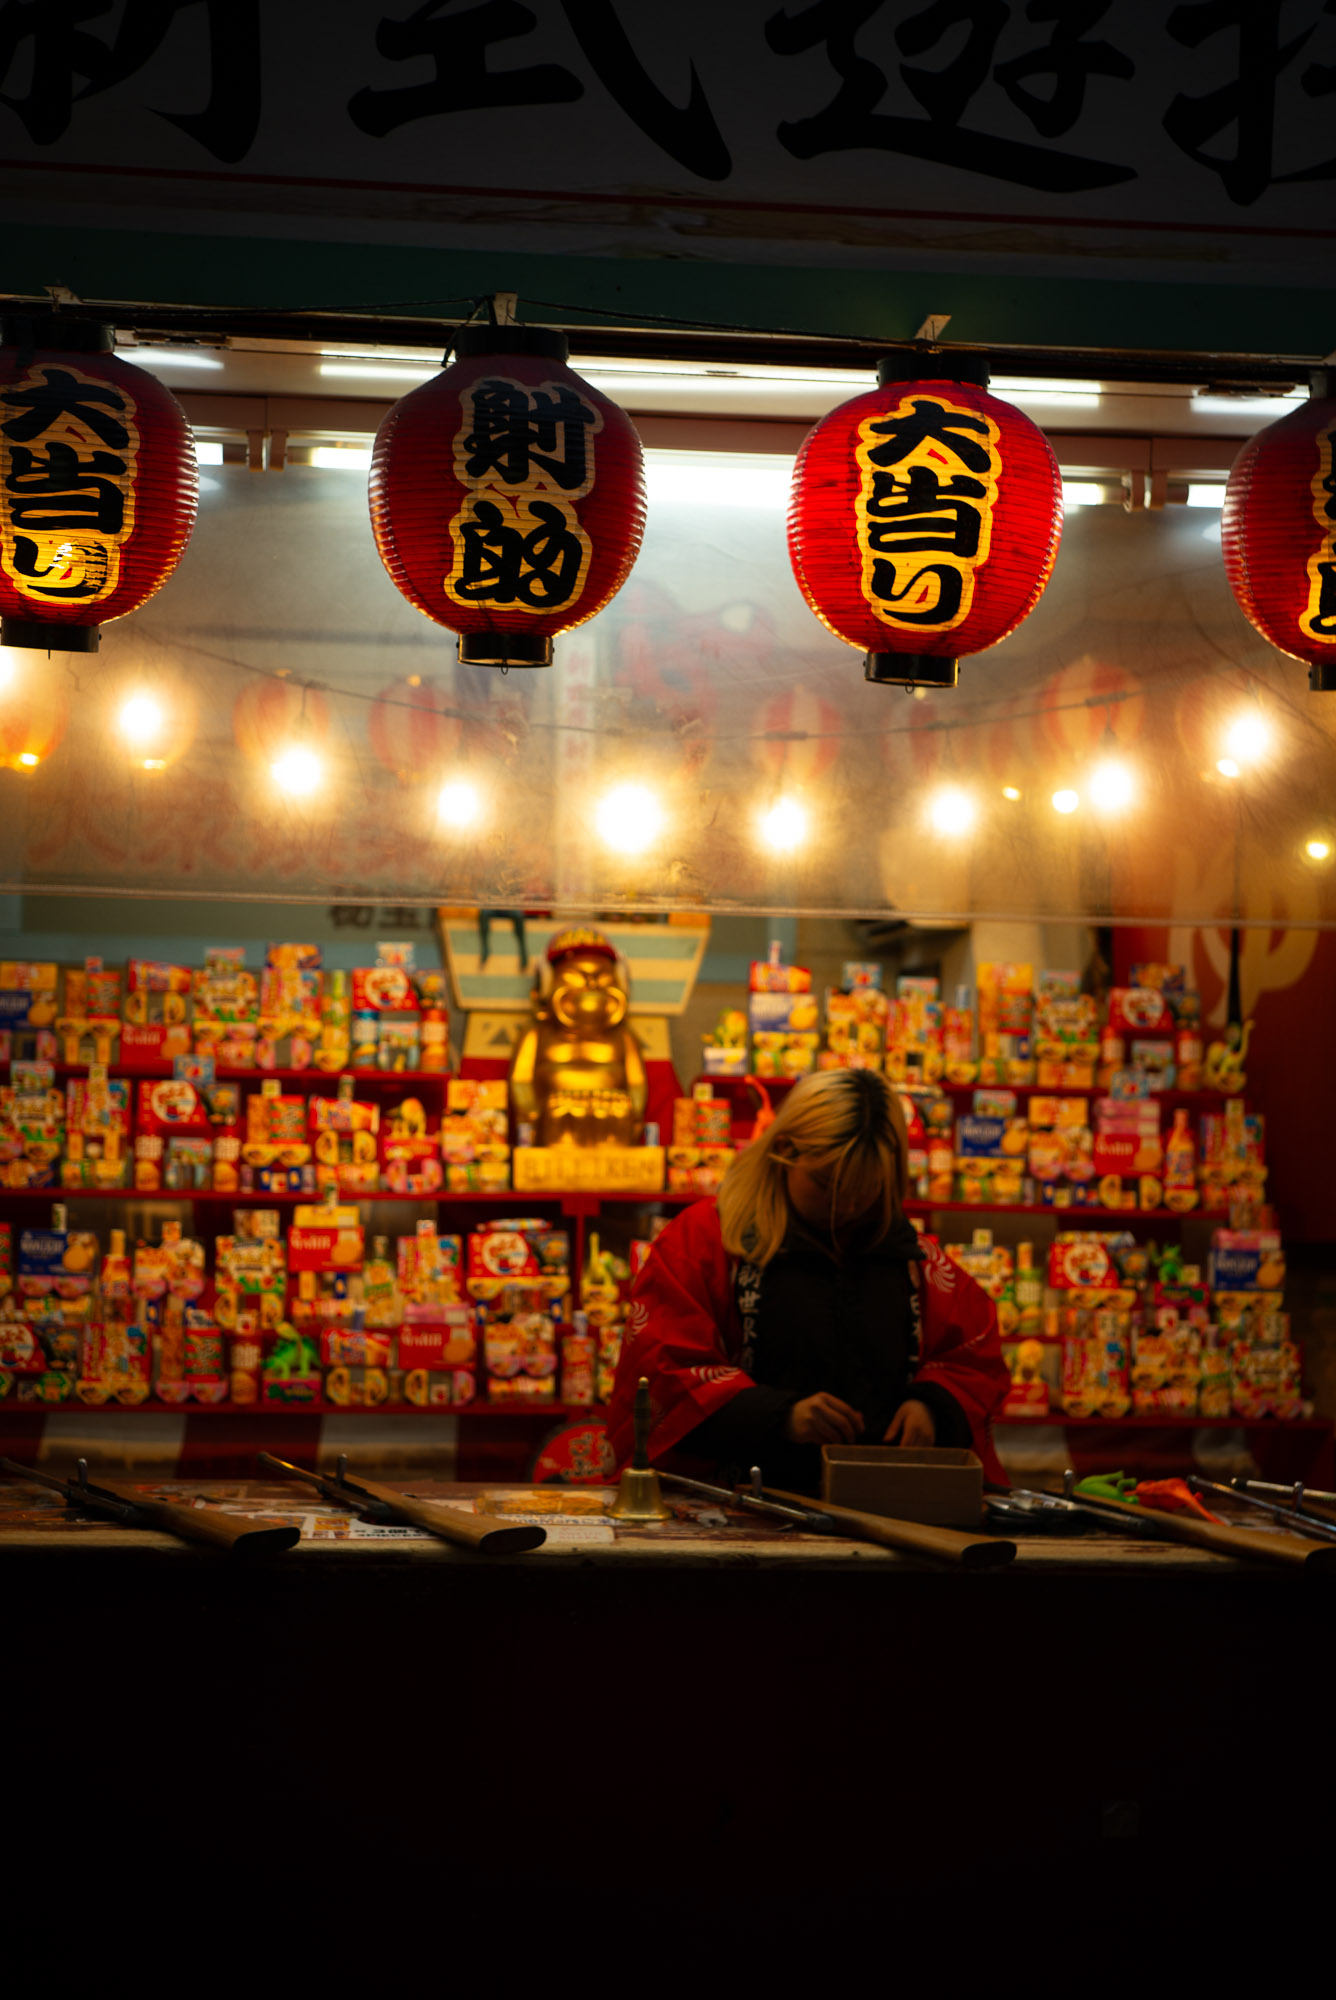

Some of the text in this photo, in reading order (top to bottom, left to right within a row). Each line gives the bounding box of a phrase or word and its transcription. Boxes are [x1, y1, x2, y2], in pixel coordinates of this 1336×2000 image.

[0, 368, 131, 600] 大当り
[453, 378, 597, 608] 射的
[866, 400, 993, 625] 大当り
